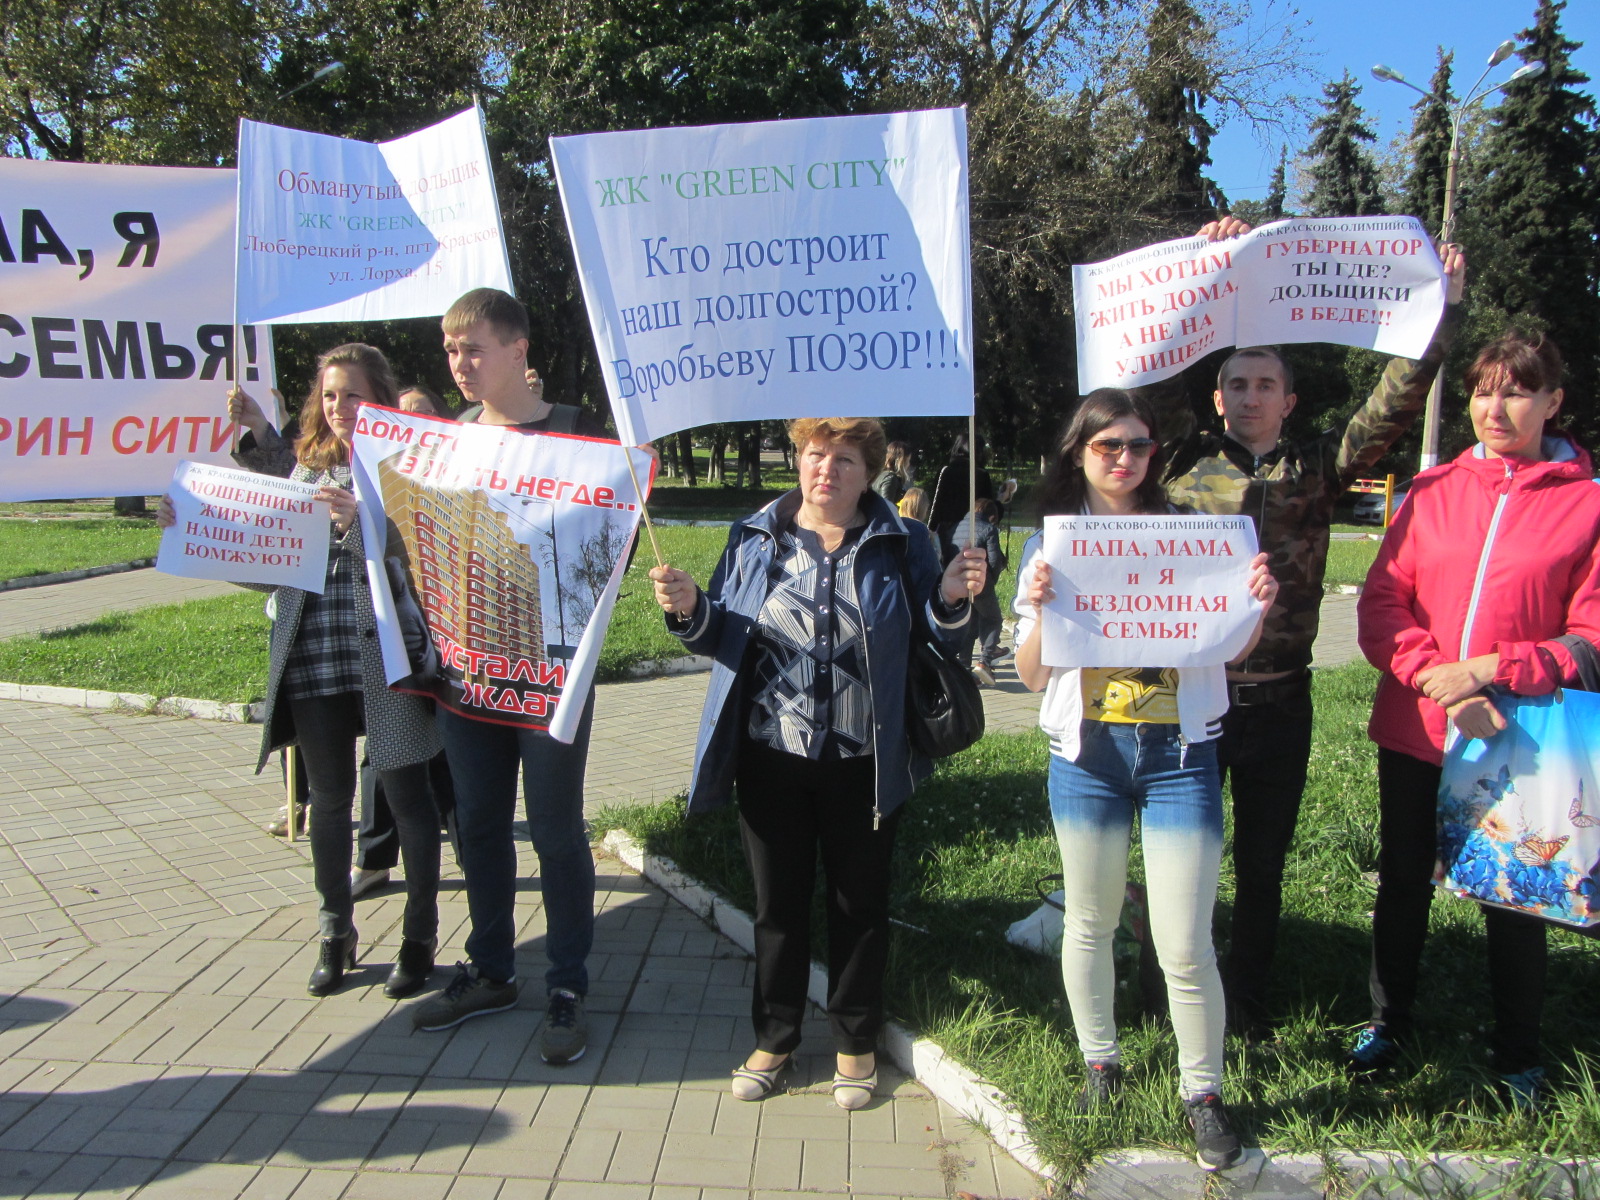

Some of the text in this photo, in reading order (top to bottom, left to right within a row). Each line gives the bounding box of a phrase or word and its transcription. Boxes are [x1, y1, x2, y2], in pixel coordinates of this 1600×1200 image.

[278, 168, 403, 204] Обманутый
[595, 157, 906, 207] ЖК "GREEN CITY"
[298, 202, 466, 232] ЖК "GREEN CITY"
[1256, 220, 1423, 239] ЖК КРАСКОВО-ОЛИМПИЙСКИ
[113, 212, 160, 268] Я
[243, 235, 361, 260] Люберецкий
[405, 242, 432, 255] пгт
[1265, 238, 1423, 259] ГУБЕРНАТОР
[641, 231, 889, 278] Кто достроит
[328, 261, 442, 285] ул. Лорха, 15
[1088, 268, 1105, 277] ЖК
[1097, 251, 1233, 301] МЫ ХОТИМ
[1292, 261, 1391, 279] ТЫ ГДЕ?
[621, 271, 917, 336] наш долгострой?
[1090, 280, 1238, 329] ЖИТЬ ДОМА,
[1269, 283, 1412, 304] ДОЛЬЩИКИ
[1290, 306, 1392, 326] В БЕДЕ!!!
[1120, 313, 1213, 349] А НЕ НА
[610, 329, 959, 402] Воробьеву ПОЗОР!!!
[1115, 330, 1215, 377] УЛИЦЕ!!!
[112, 416, 242, 455] СИТИ
[189, 466, 202, 475] ЖК
[188, 480, 314, 514] МОШЕННИКИ
[200, 502, 293, 532] ЖИРУЮТ,
[1058, 519, 1246, 530] ЖК КРАСКОВО-ОЛИМПИЙСКИЙ
[186, 521, 304, 549] НАШИ ДЕТИ
[184, 542, 301, 567] БОМЖУЮТ!
[1071, 539, 1233, 560] ПАПА, МАМА
[1127, 568, 1175, 585] и Я
[1074, 594, 1228, 613] БЕЗДОМНАЯ
[1102, 621, 1198, 639] СЕМЬЯ!
